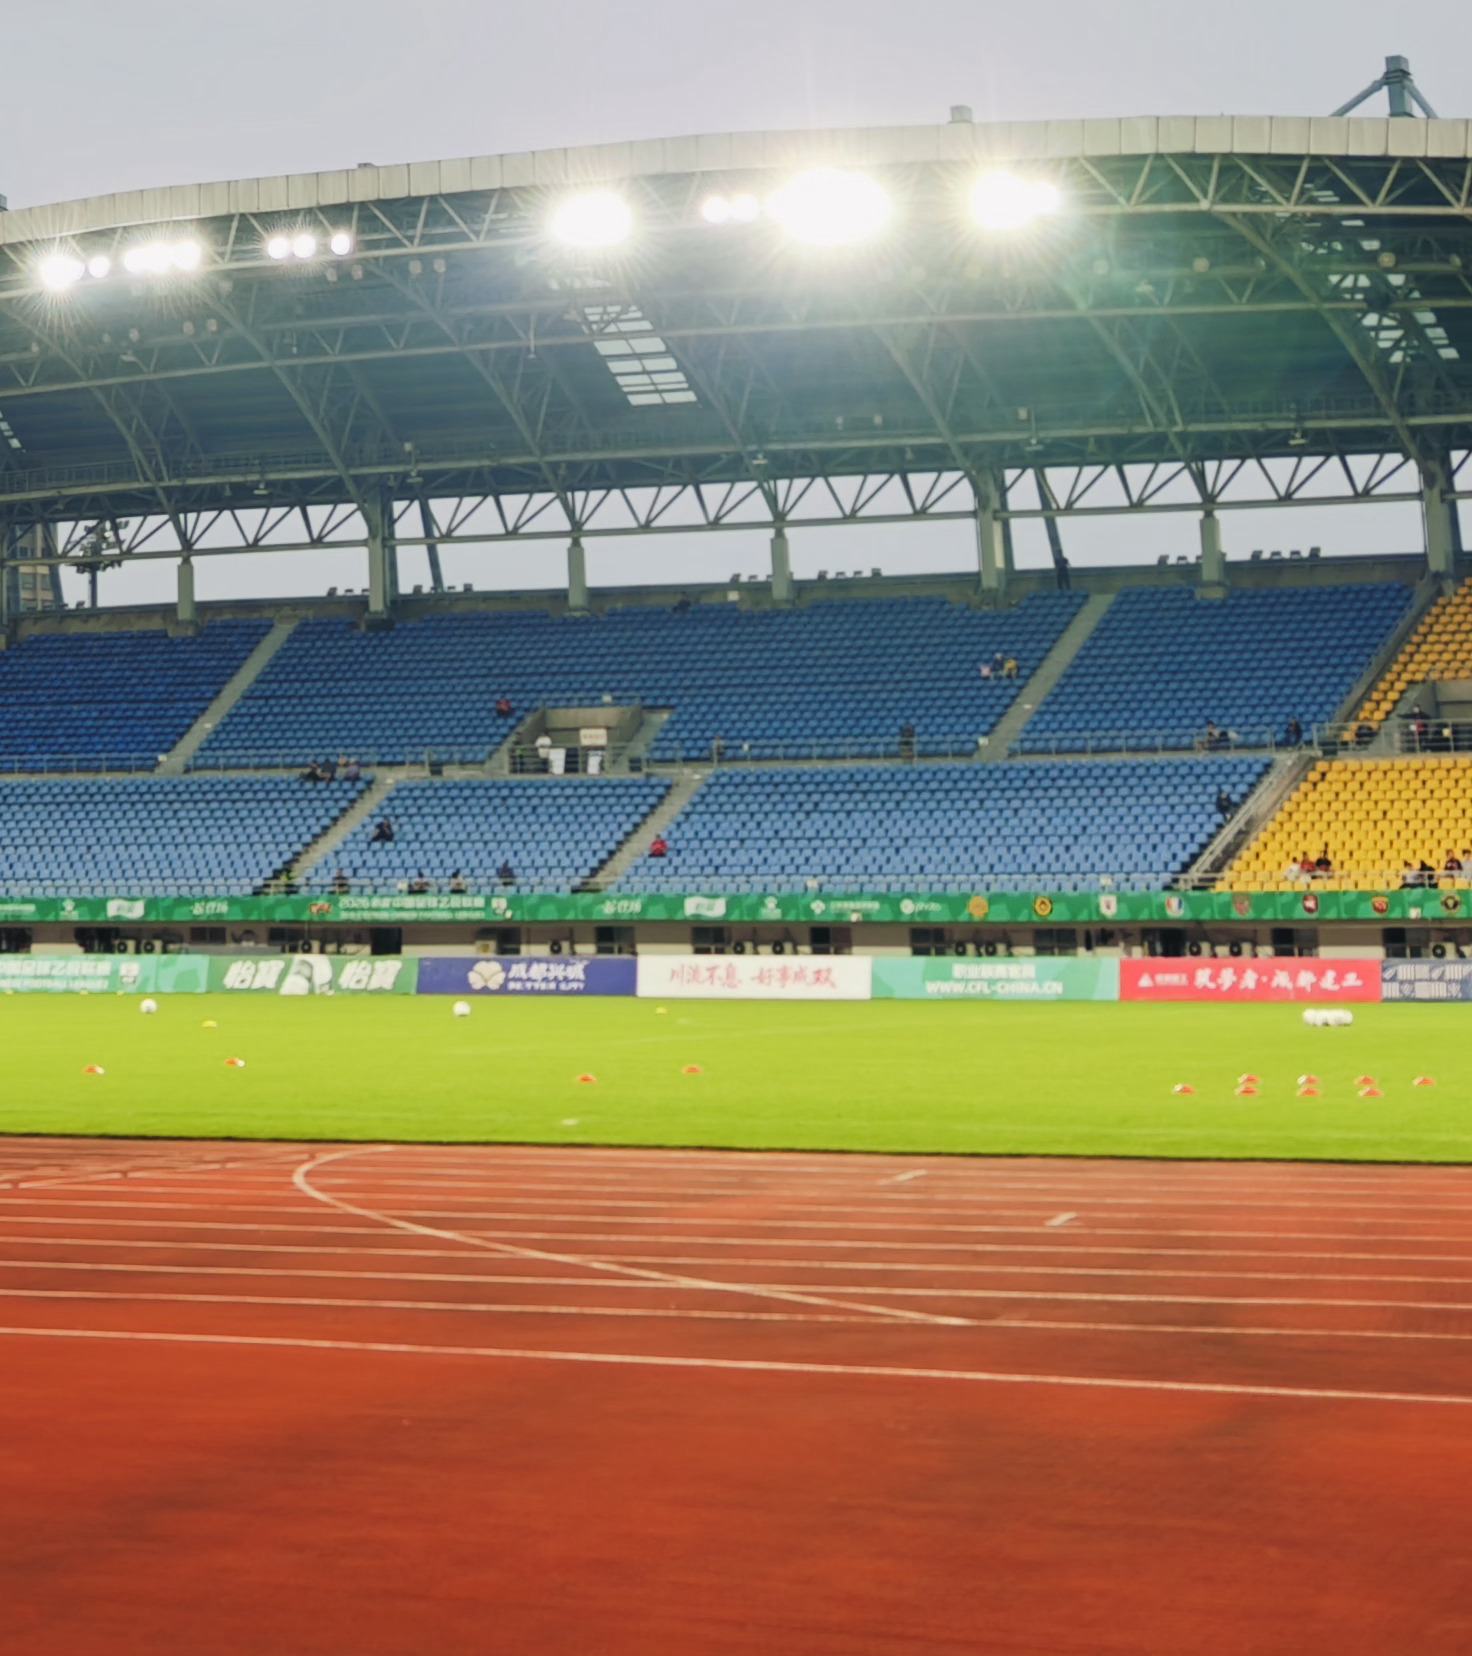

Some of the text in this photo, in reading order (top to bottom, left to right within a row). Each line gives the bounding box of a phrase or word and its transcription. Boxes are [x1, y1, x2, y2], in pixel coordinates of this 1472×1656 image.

[668, 962, 837, 989] 川流不息 好事成双
